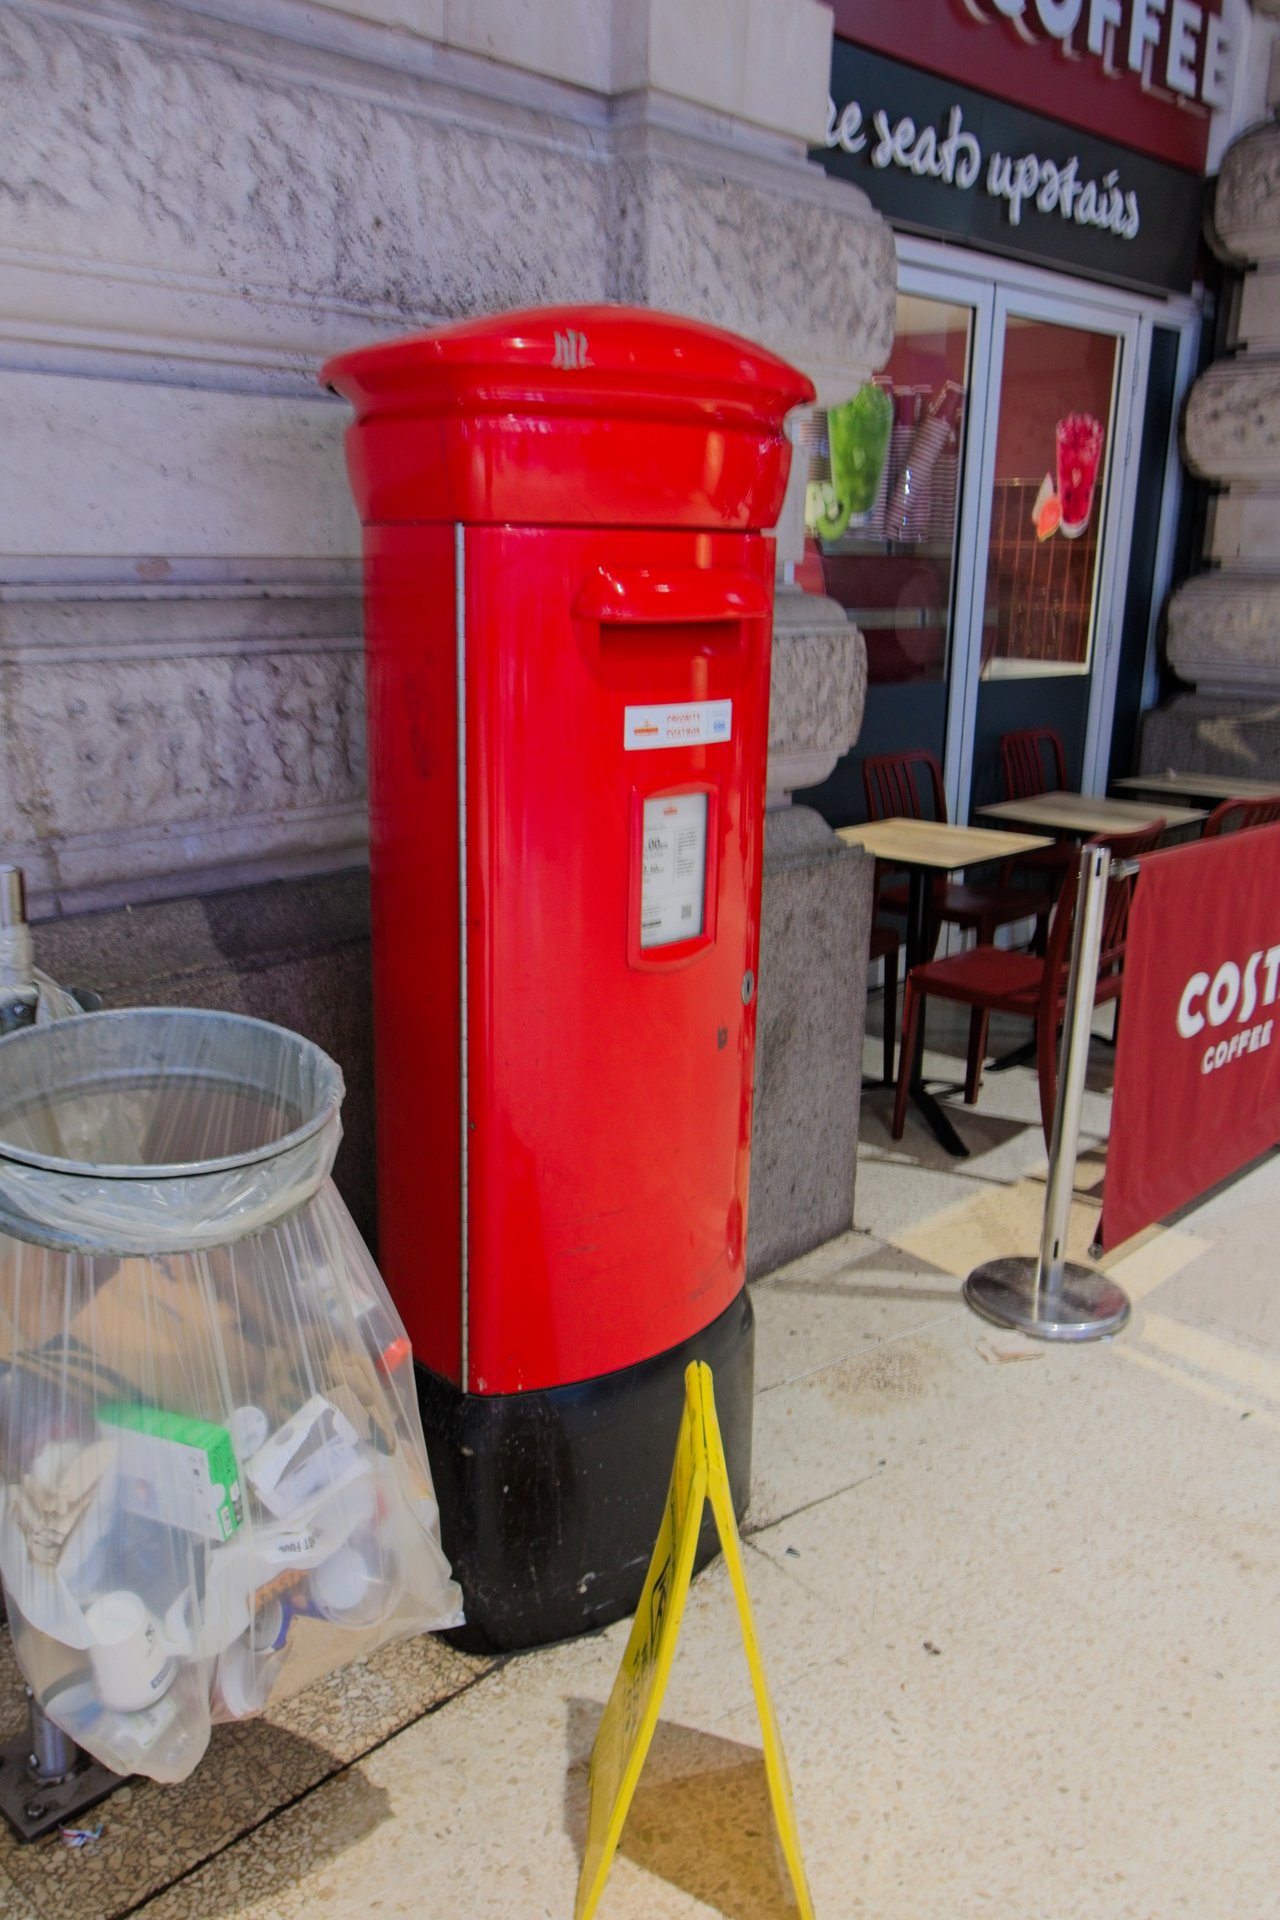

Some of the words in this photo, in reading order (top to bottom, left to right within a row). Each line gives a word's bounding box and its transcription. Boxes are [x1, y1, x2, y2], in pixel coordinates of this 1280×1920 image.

[990, 0, 1226, 107] FFEE
[987, 152, 1139, 240] upstairs
[1176, 944, 1280, 1039] COST
[1203, 1020, 1274, 1074] COFFEE
